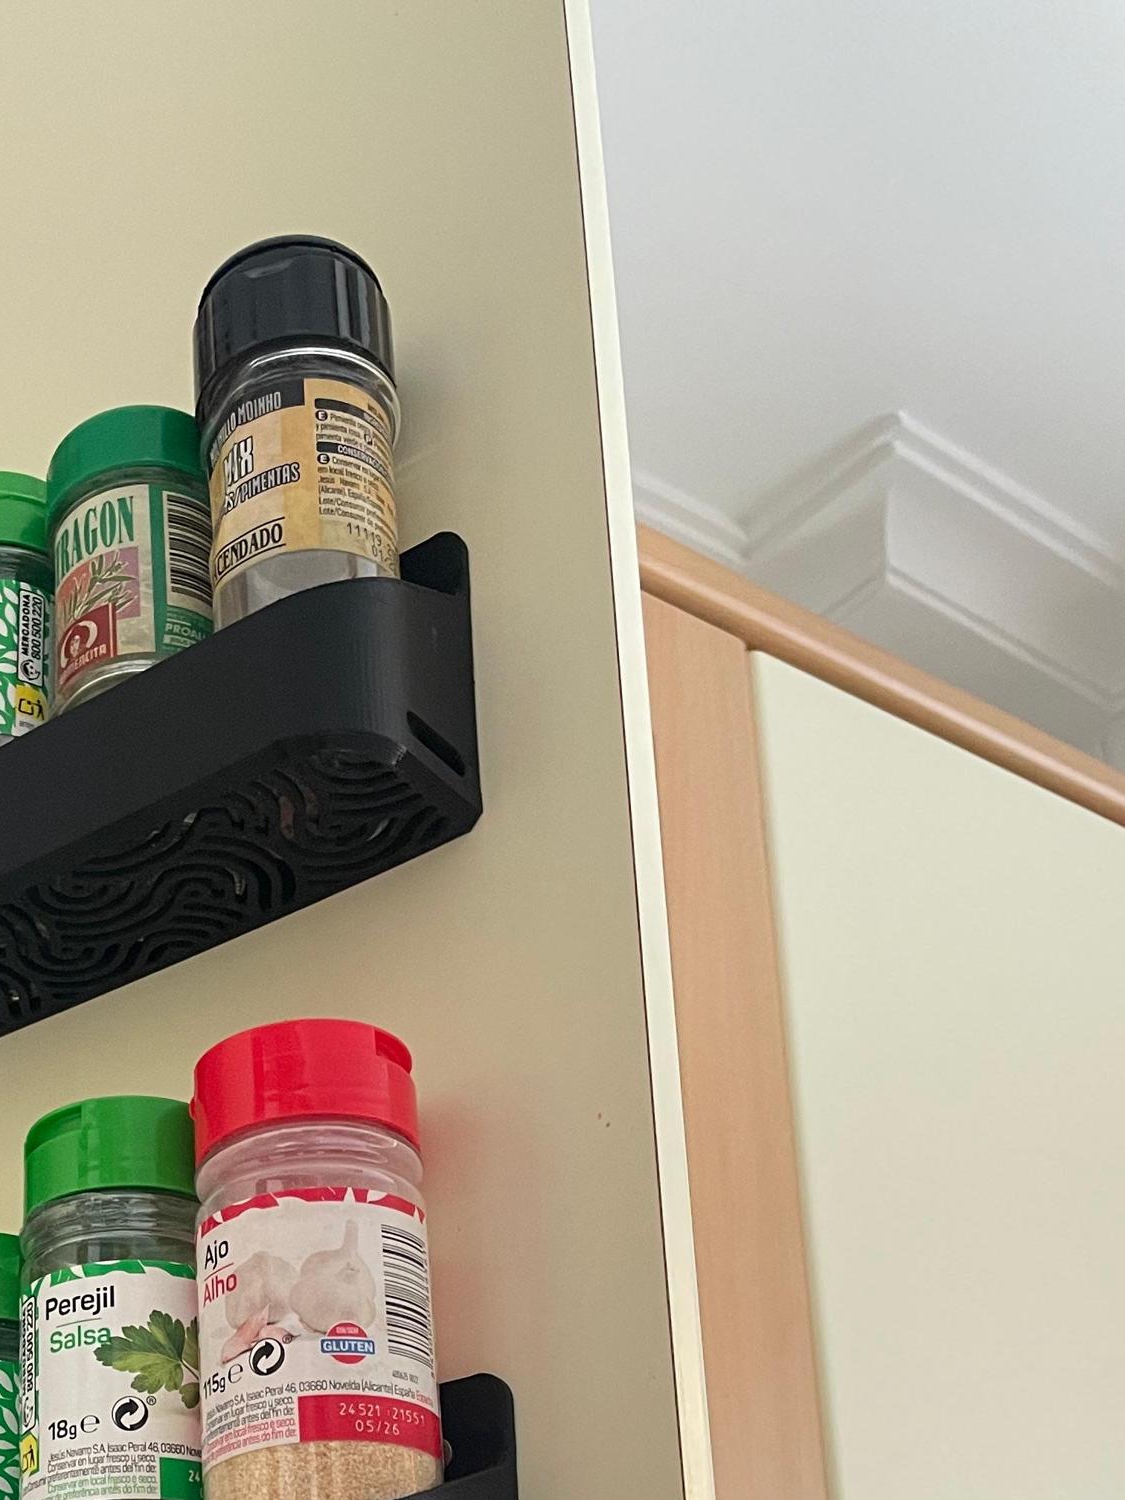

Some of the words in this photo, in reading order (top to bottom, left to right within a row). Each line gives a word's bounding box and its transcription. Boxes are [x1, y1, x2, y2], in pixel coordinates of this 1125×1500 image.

[237, 391, 281, 426] MOINHO
[33, 597, 43, 616] 220
[32, 616, 42, 637] 500
[204, 1237, 229, 1270] Ajo
[203, 1271, 237, 1307] Alho
[45, 1285, 115, 1320] Perejil
[50, 1326, 111, 1353] Salsa
[324, 1340, 374, 1353] GLUTEN
[203, 1373, 226, 1400] 115g
[299, 1380, 327, 1392] 03660
[329, 1380, 360, 1391] Novelda
[48, 1420, 77, 1440] 18g
[356, 1420, 400, 1435] 05/26
[106, 1453, 129, 1462] fresco
[128, 1442, 146, 1451] Peral
[160, 1443, 185, 1454] 03660
[188, 1470, 200, 1482] 24
